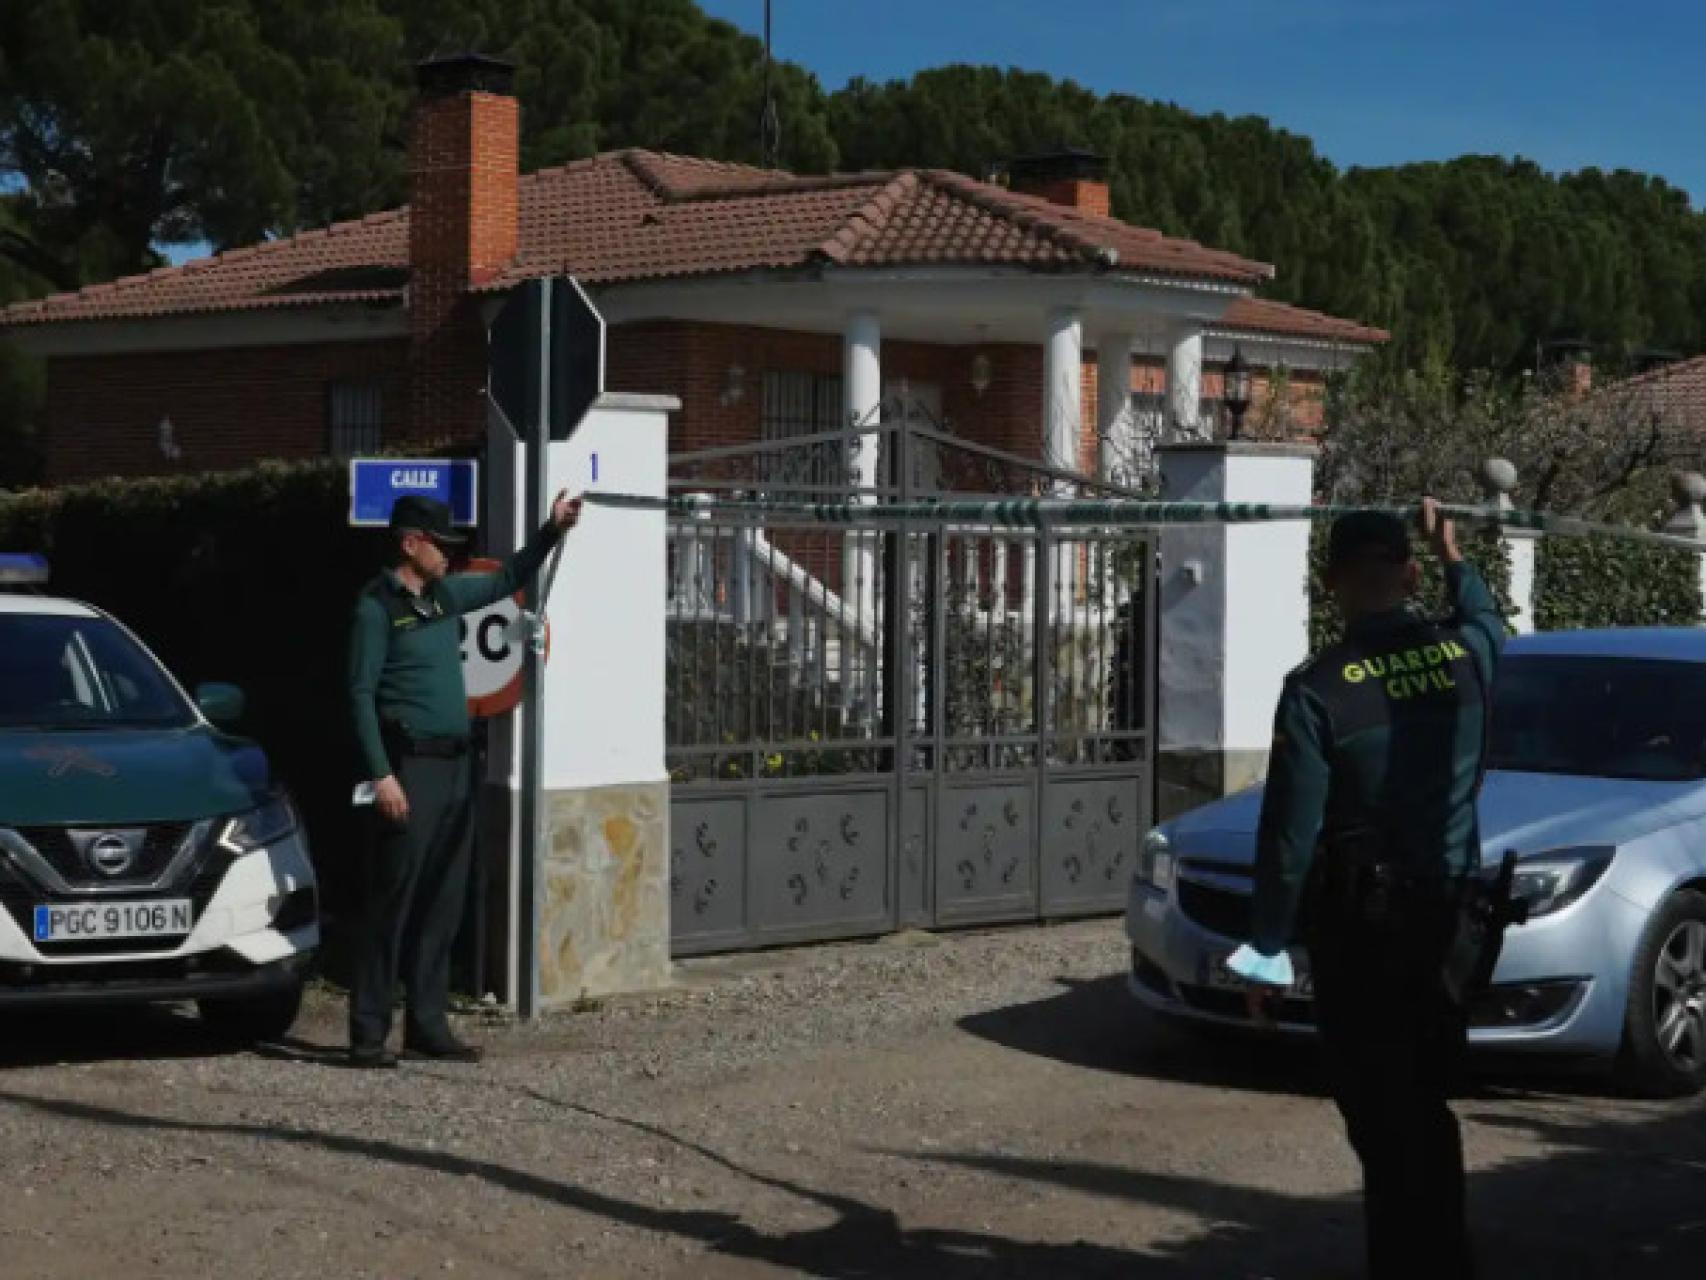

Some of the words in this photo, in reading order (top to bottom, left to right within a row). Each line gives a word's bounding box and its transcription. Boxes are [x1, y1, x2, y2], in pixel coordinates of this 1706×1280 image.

[391, 469, 438, 489] CALLE
[589, 451, 599, 483] 1
[1387, 670, 1456, 698] CIVIL
[50, 908, 97, 935] PGC
[103, 904, 167, 932] 9106
[171, 904, 187, 929] N
